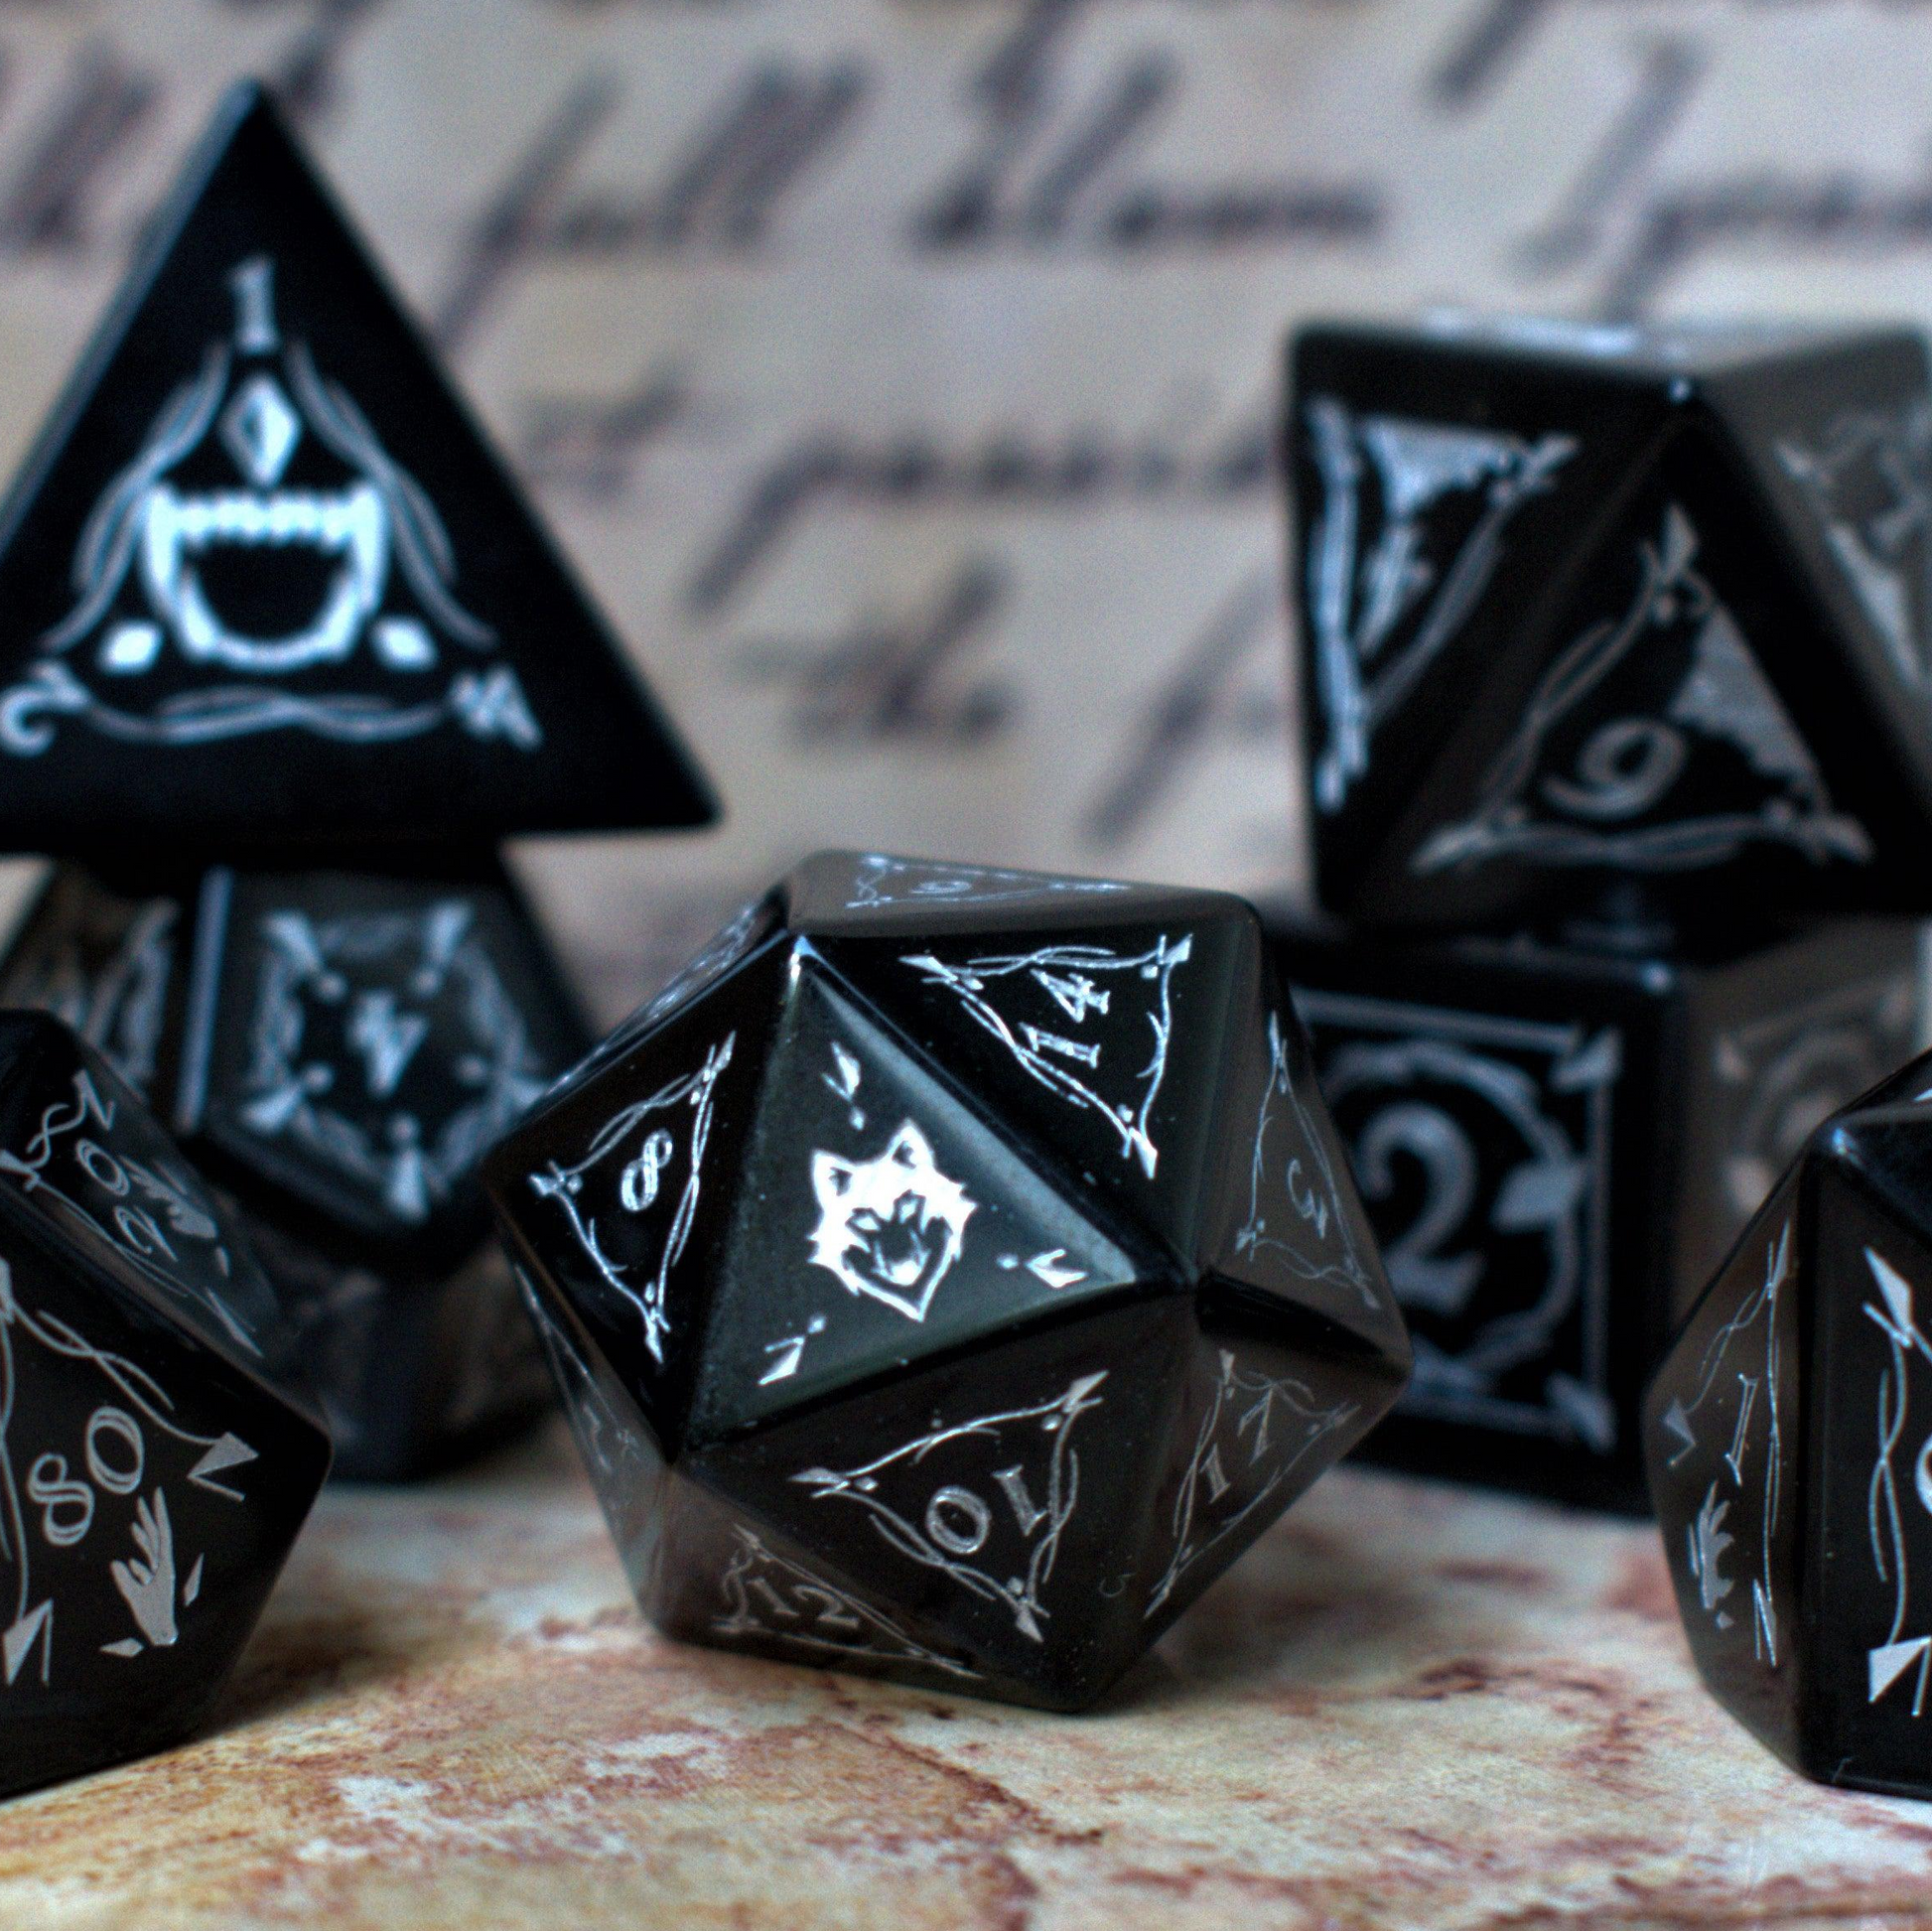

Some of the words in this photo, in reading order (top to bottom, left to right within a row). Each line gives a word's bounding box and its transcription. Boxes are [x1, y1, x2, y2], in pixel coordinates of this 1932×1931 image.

[226, 253, 276, 352] 1
[621, 1129, 673, 1213] 8
[1356, 1101, 1485, 1320] 2
[27, 1406, 146, 1549] 80
[747, 1577, 861, 1629] 12
